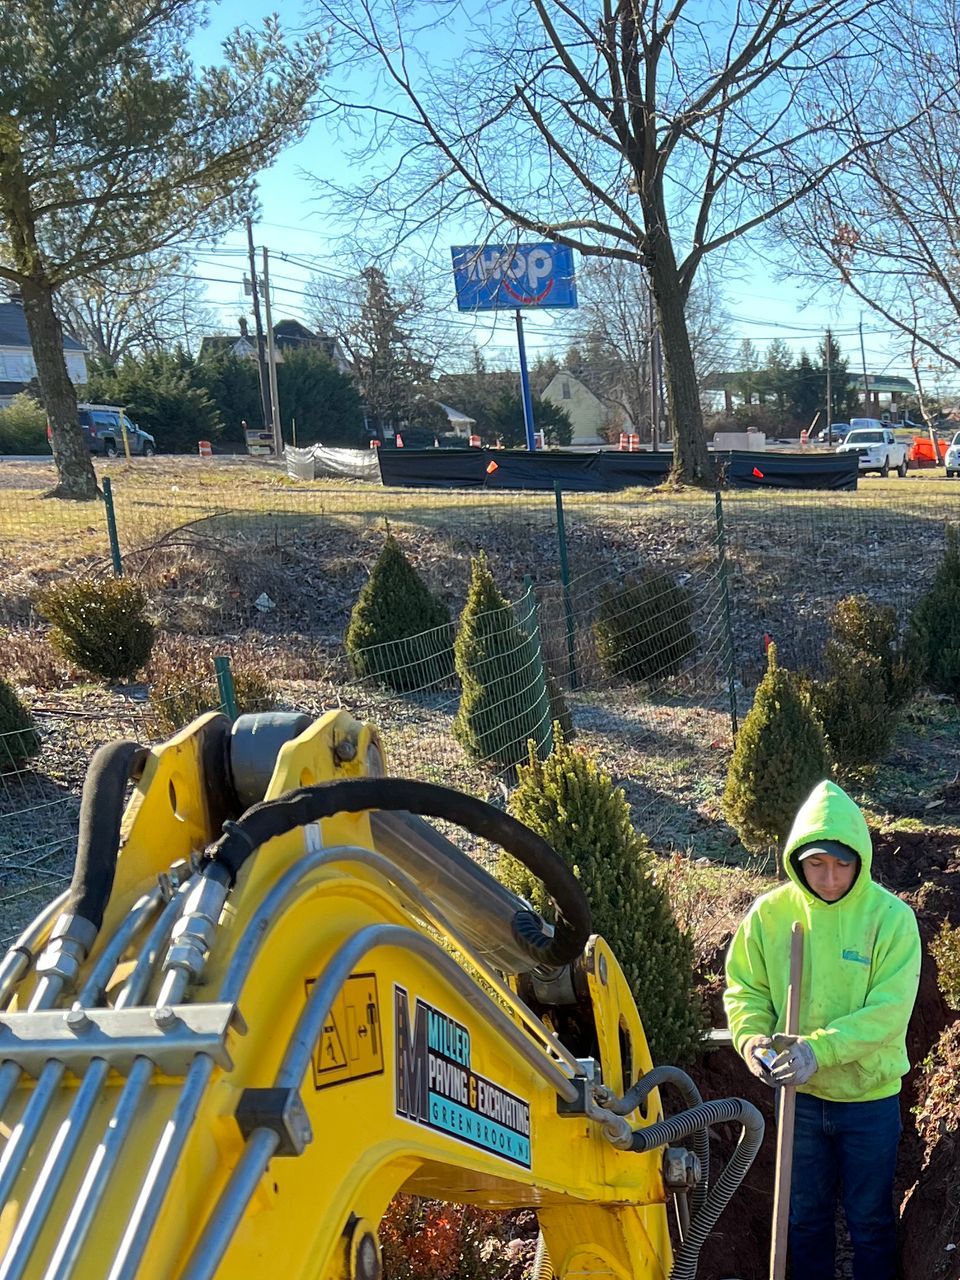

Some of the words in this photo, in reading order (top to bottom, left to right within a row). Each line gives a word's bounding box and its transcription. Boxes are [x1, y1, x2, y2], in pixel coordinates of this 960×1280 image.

[428, 1009, 470, 1068] MILLER
[428, 1053, 468, 1105] PAVING
[469, 1075, 477, 1109] &
[478, 1080, 529, 1136] EXCAVATING
[518, 1142, 528, 1160] NJ
